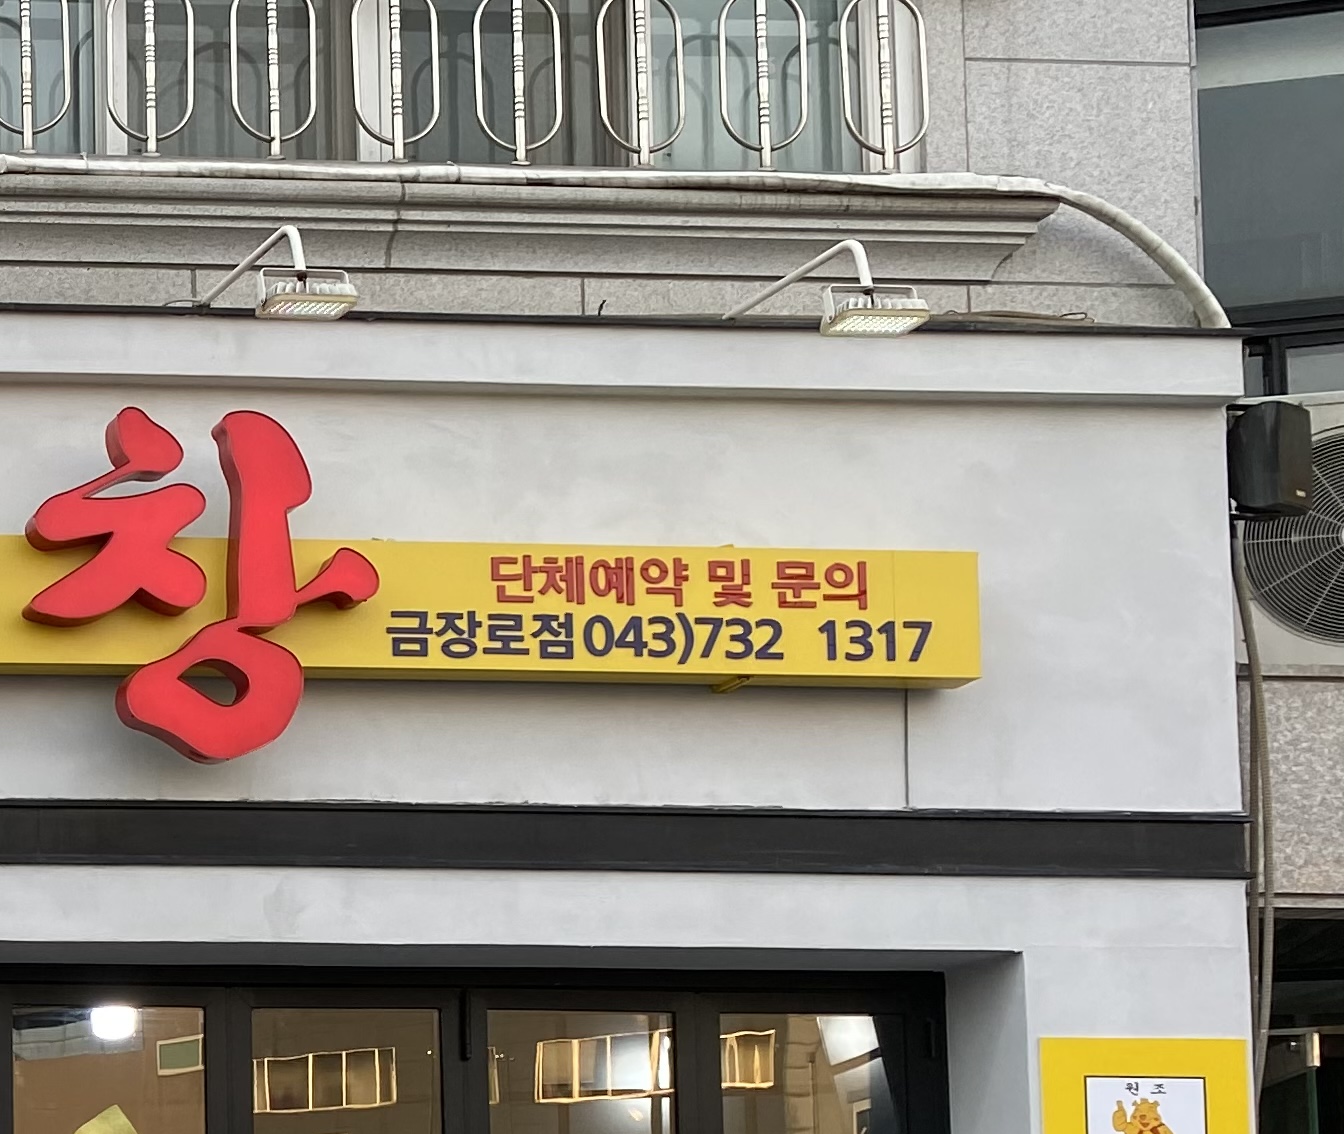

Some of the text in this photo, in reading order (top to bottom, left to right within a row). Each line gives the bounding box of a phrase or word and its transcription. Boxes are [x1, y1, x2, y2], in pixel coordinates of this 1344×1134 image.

[489, 554, 869, 611] 단체예약 및 문의
[818, 619, 934, 663] 1317
